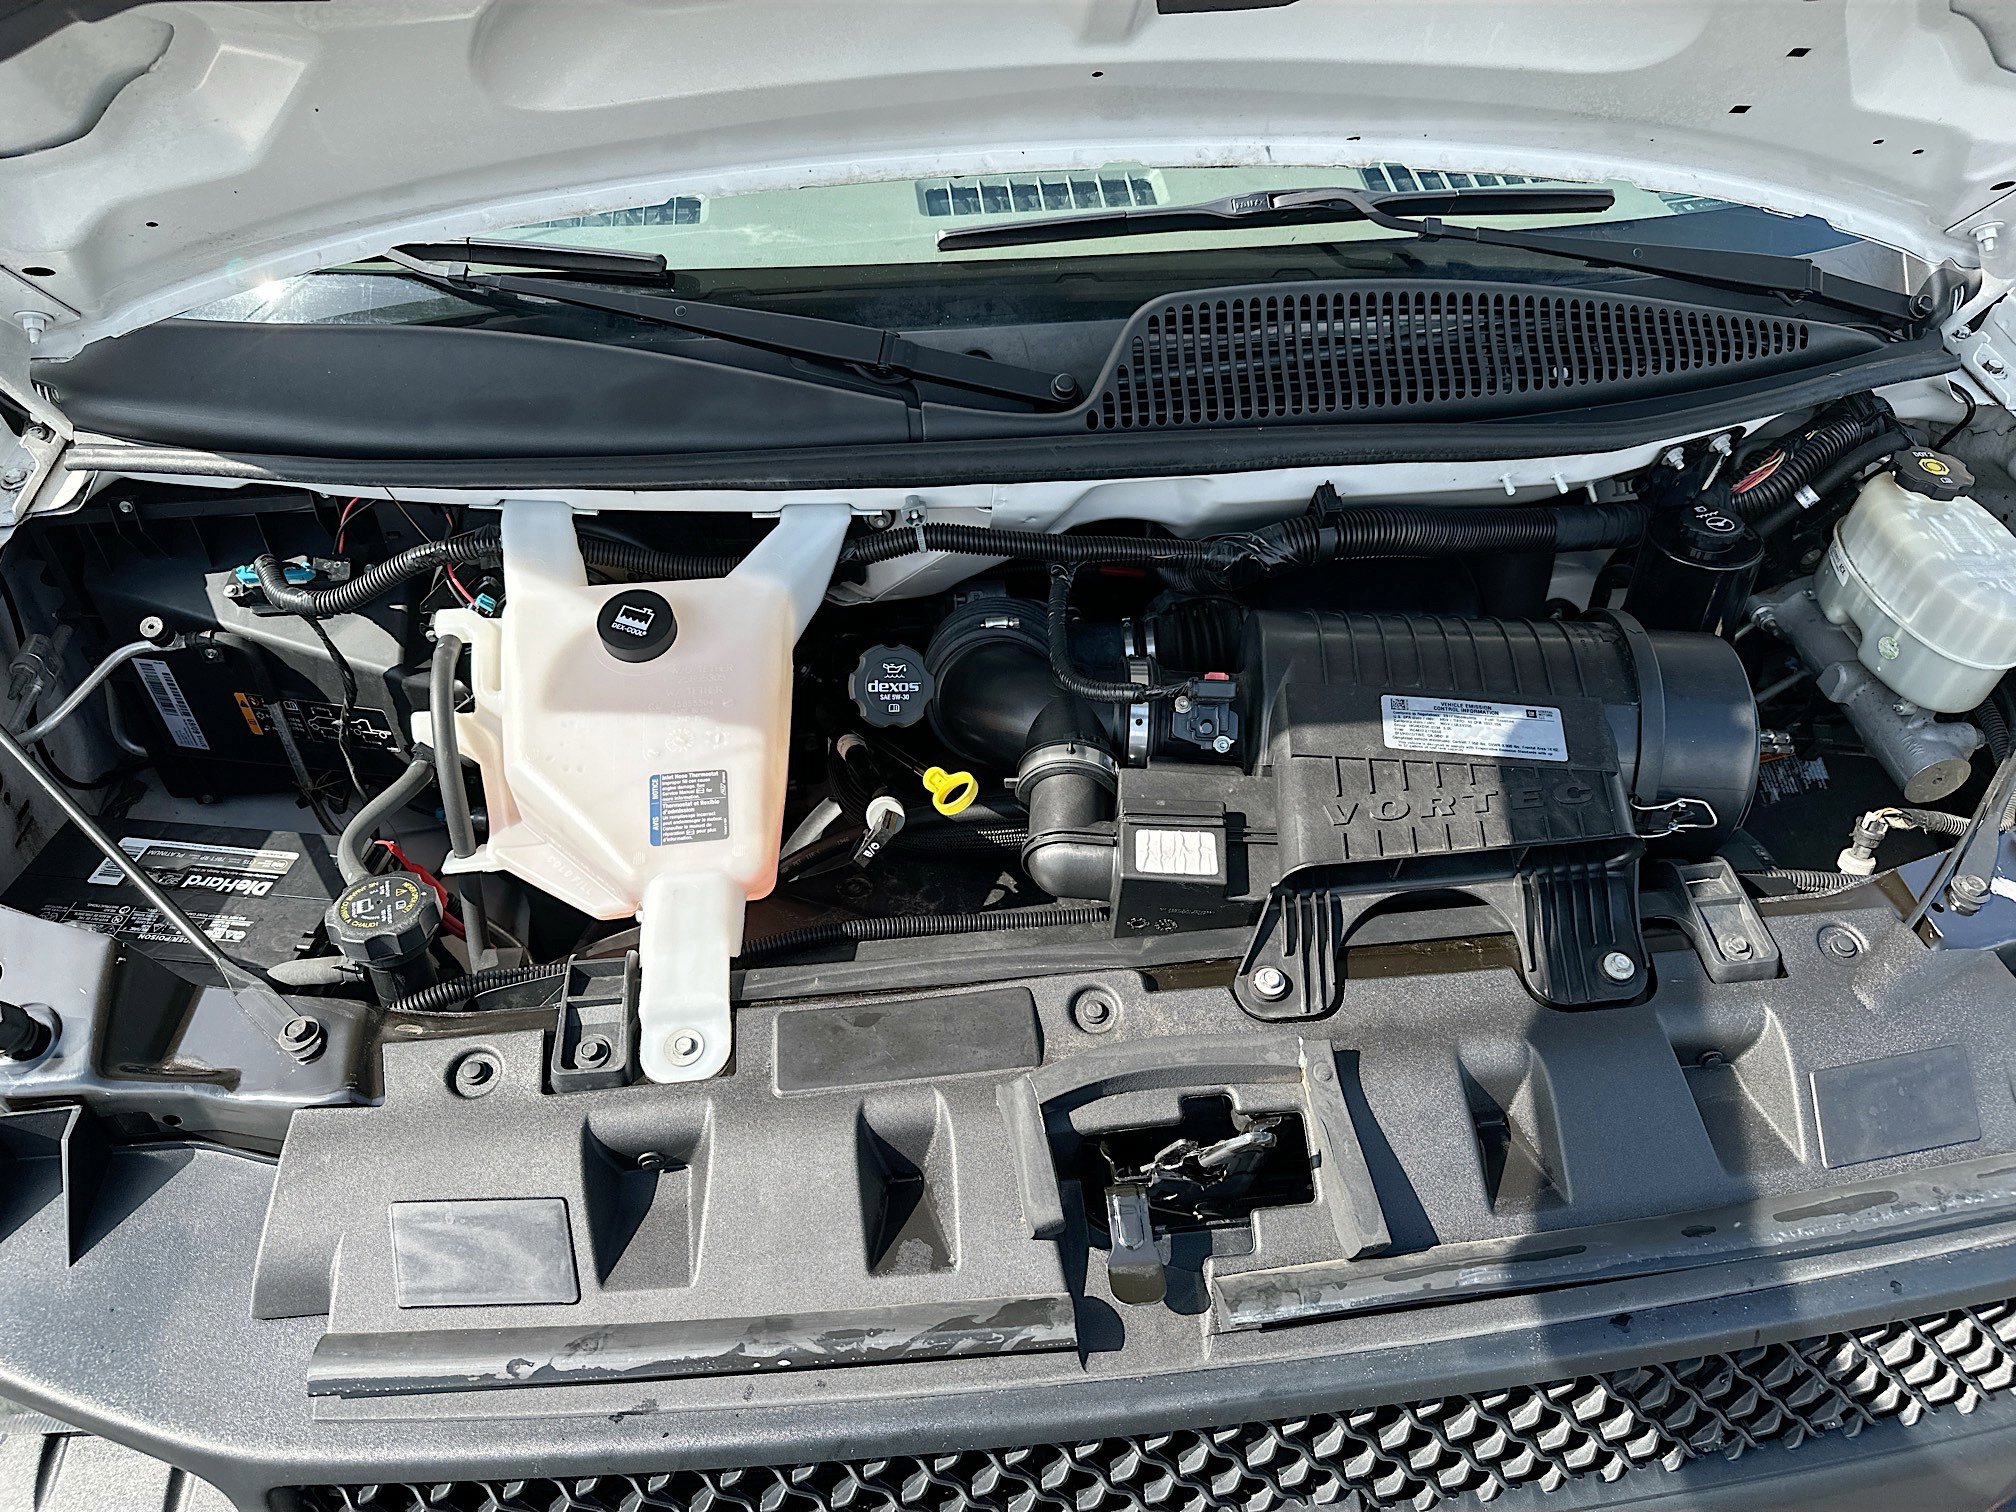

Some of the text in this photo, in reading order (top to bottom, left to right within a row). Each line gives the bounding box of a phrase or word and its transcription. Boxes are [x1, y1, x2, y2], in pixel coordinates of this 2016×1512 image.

[867, 679, 920, 692] dexos
[1461, 708, 1499, 716] INFORMATION
[651, 779, 659, 800] NOTICE
[1323, 782, 1593, 826] VORTEC
[652, 816, 660, 831] AVIS
[147, 849, 185, 858] PLATINUM
[180, 874, 273, 896] DieHard
